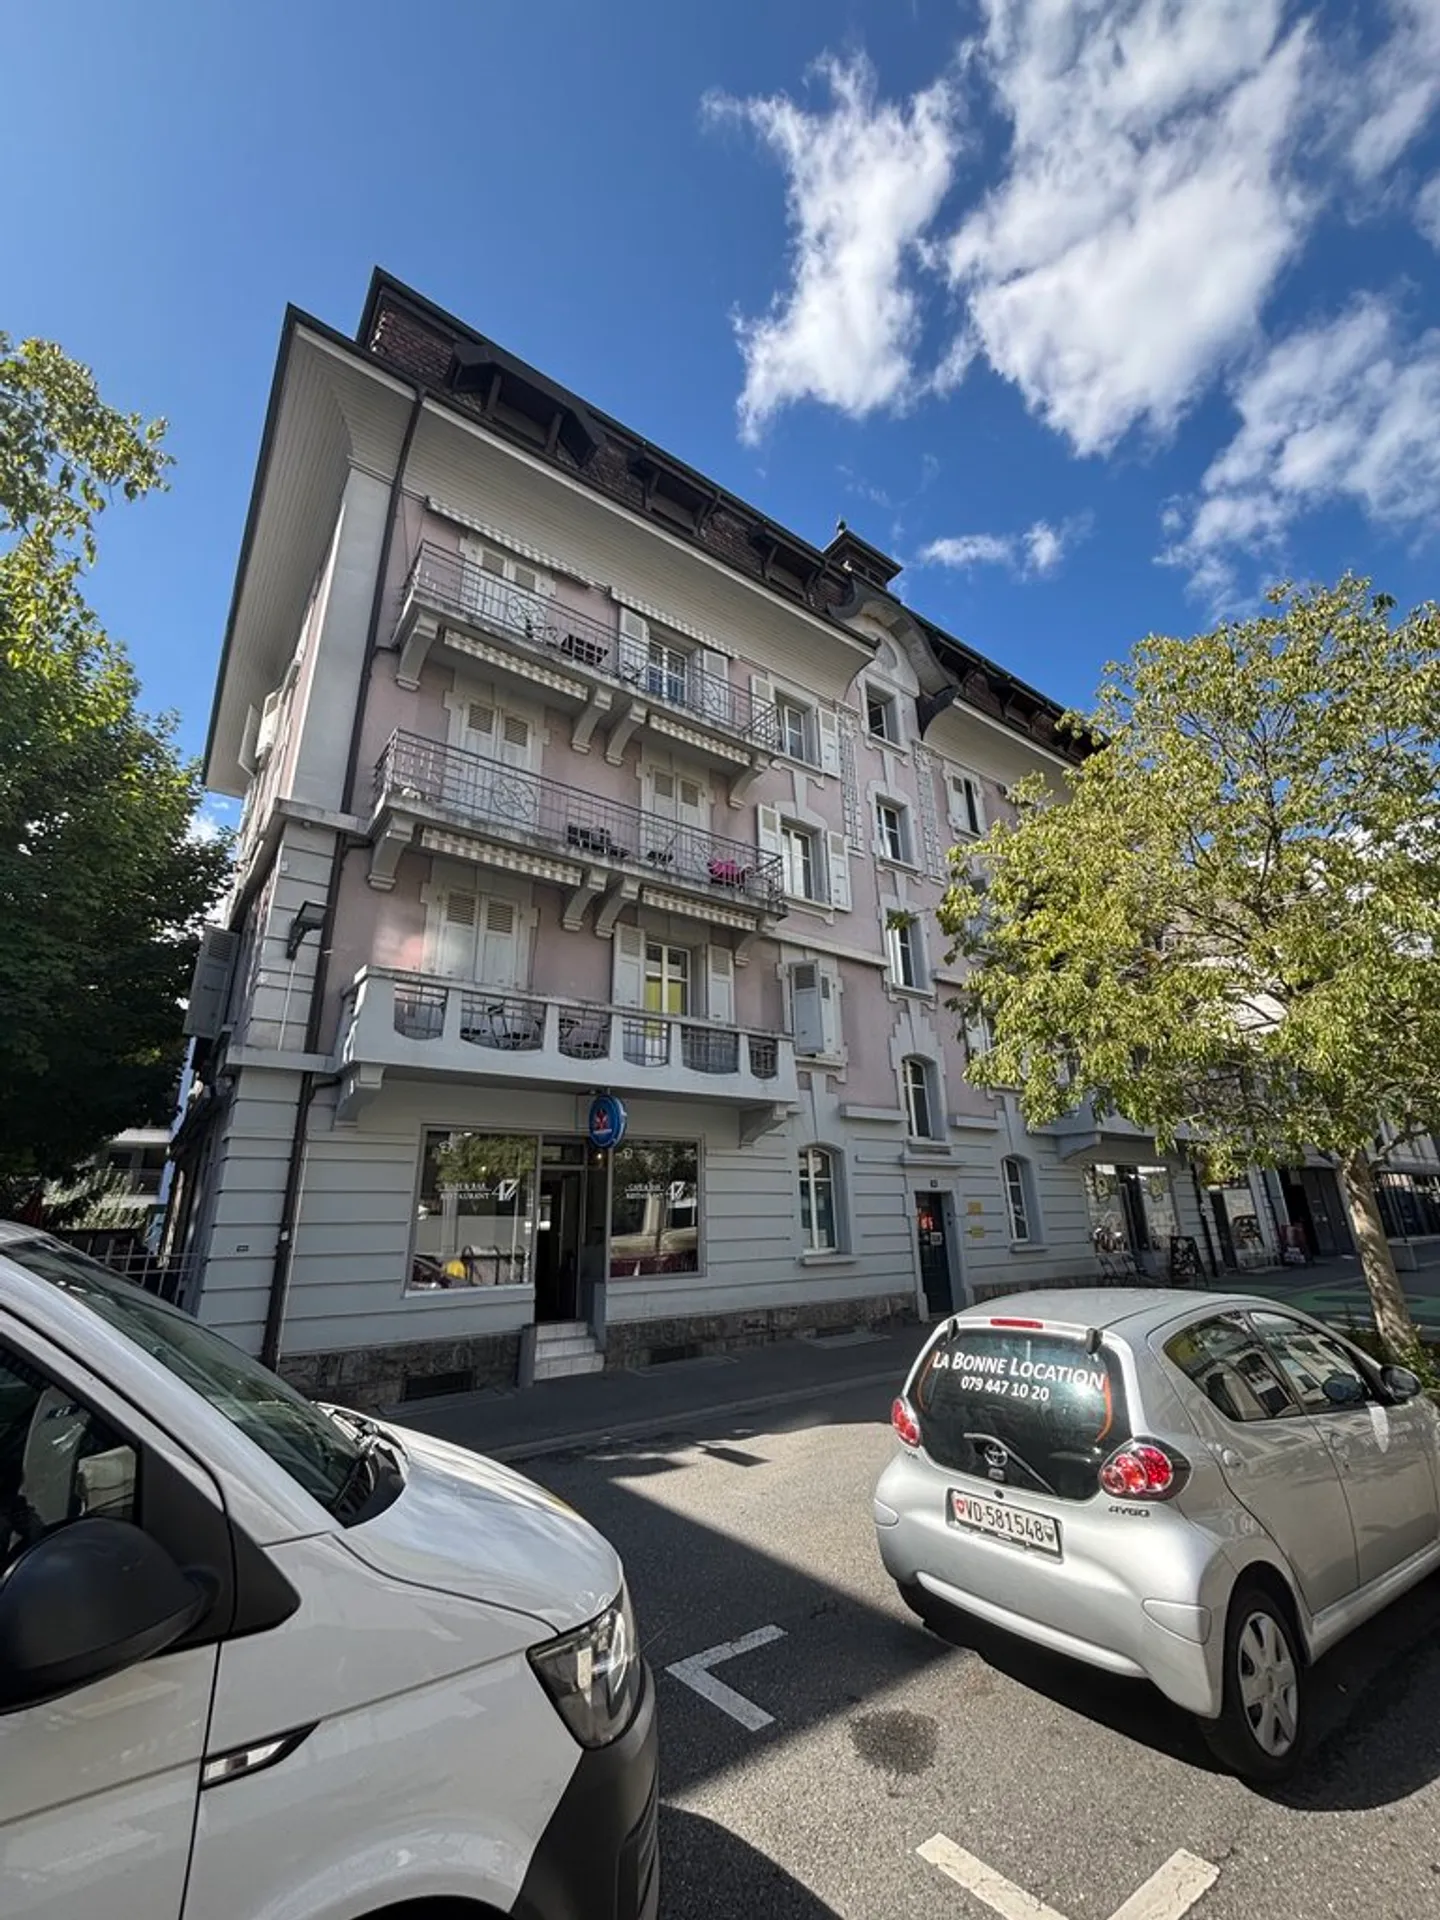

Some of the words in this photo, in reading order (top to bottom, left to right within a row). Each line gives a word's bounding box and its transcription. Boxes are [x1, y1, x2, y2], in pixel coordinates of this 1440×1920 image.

[932, 1351, 949, 1369] LA
[952, 1352, 1008, 1374] BONNE
[1010, 1357, 1105, 1391] LOCATION
[961, 1376, 984, 1391] 079
[985, 1379, 1010, 1395] 447
[1011, 1384, 1029, 1398] 10
[1031, 1386, 1050, 1402] 20
